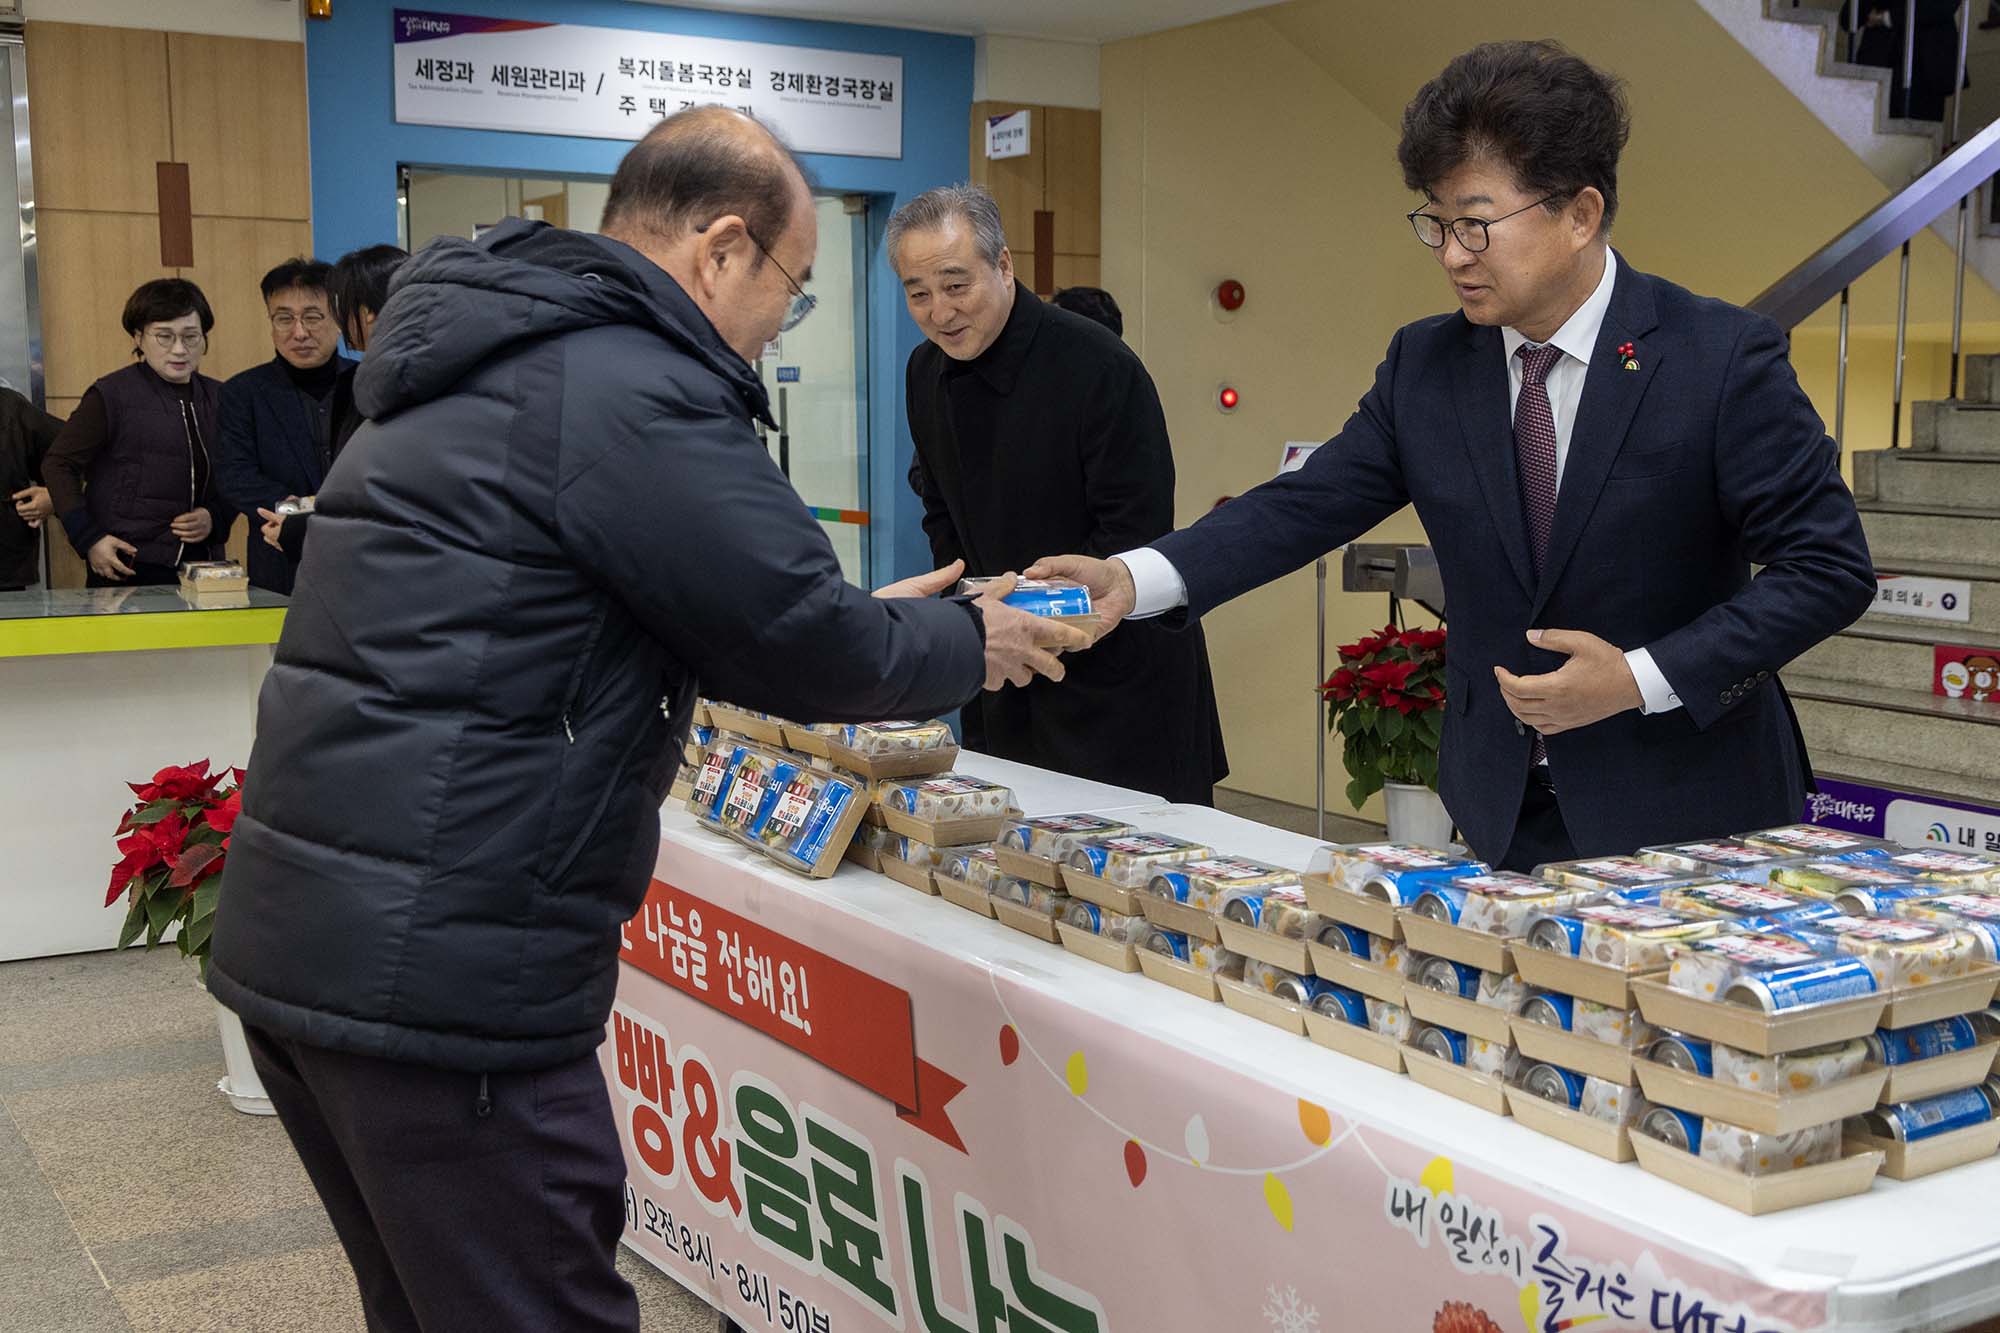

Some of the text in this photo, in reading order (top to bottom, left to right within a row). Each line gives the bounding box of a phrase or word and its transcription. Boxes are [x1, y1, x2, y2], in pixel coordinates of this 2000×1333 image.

[415, 58, 475, 84] 세정과
[491, 64, 586, 93] 세원관리과
[618, 56, 894, 102] 복지돌봄국장실 경제환경국장실
[1874, 588, 1923, 607] 회의실
[644, 900, 812, 1036] 나눔을 전해요!
[1391, 1187, 1427, 1238] 내
[1440, 1202, 1522, 1277] 일상이
[1532, 1224, 1636, 1333] 즐거운
